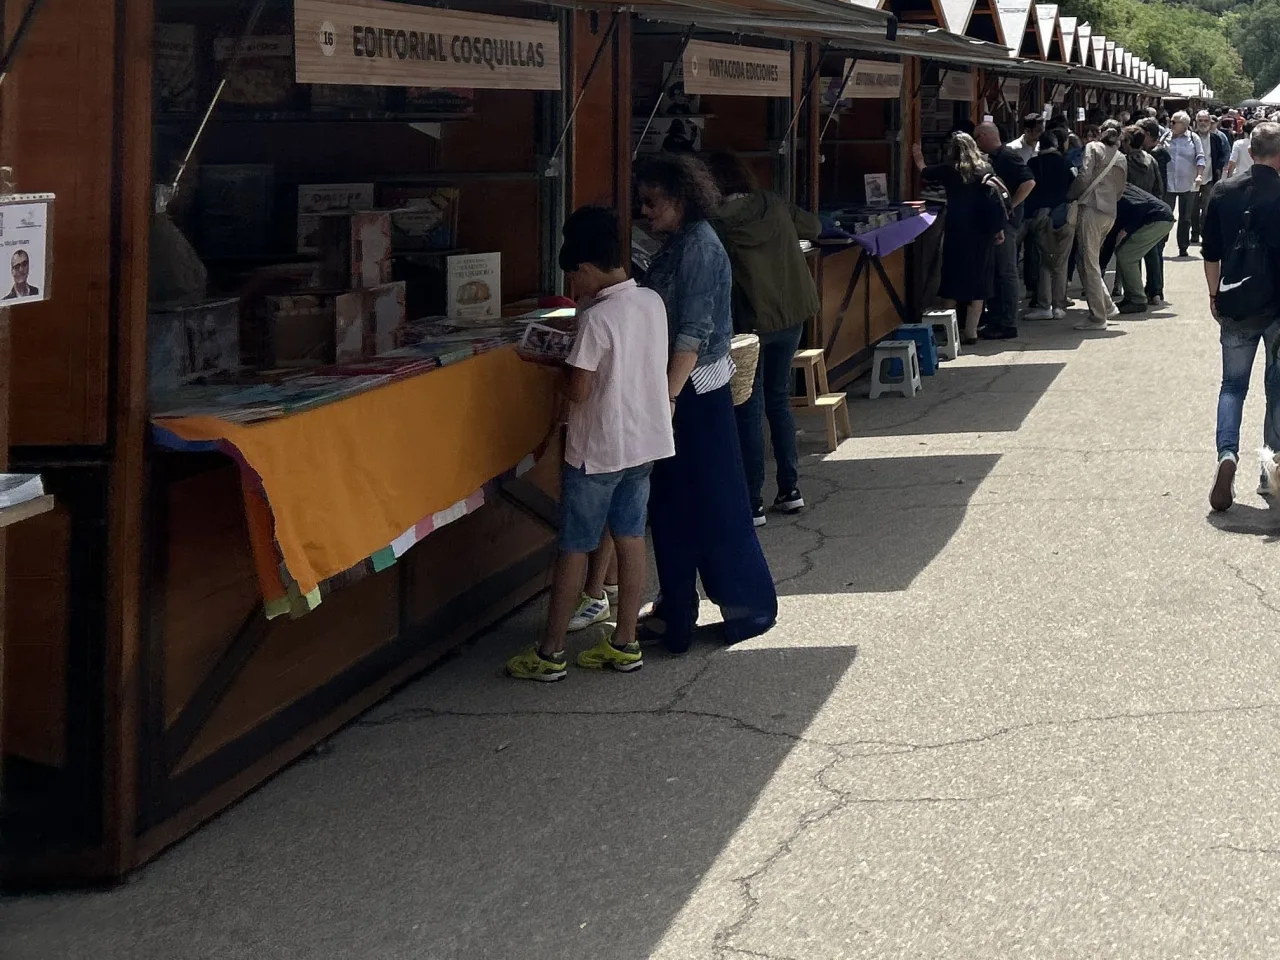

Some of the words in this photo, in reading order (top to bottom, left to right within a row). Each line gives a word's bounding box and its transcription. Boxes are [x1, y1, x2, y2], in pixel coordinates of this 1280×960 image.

[322, 31, 334, 47] 16
[353, 25, 447, 62] EDITORIAL
[450, 35, 545, 71] COSQUILLAS
[745, 62, 779, 82] EDICIONES
